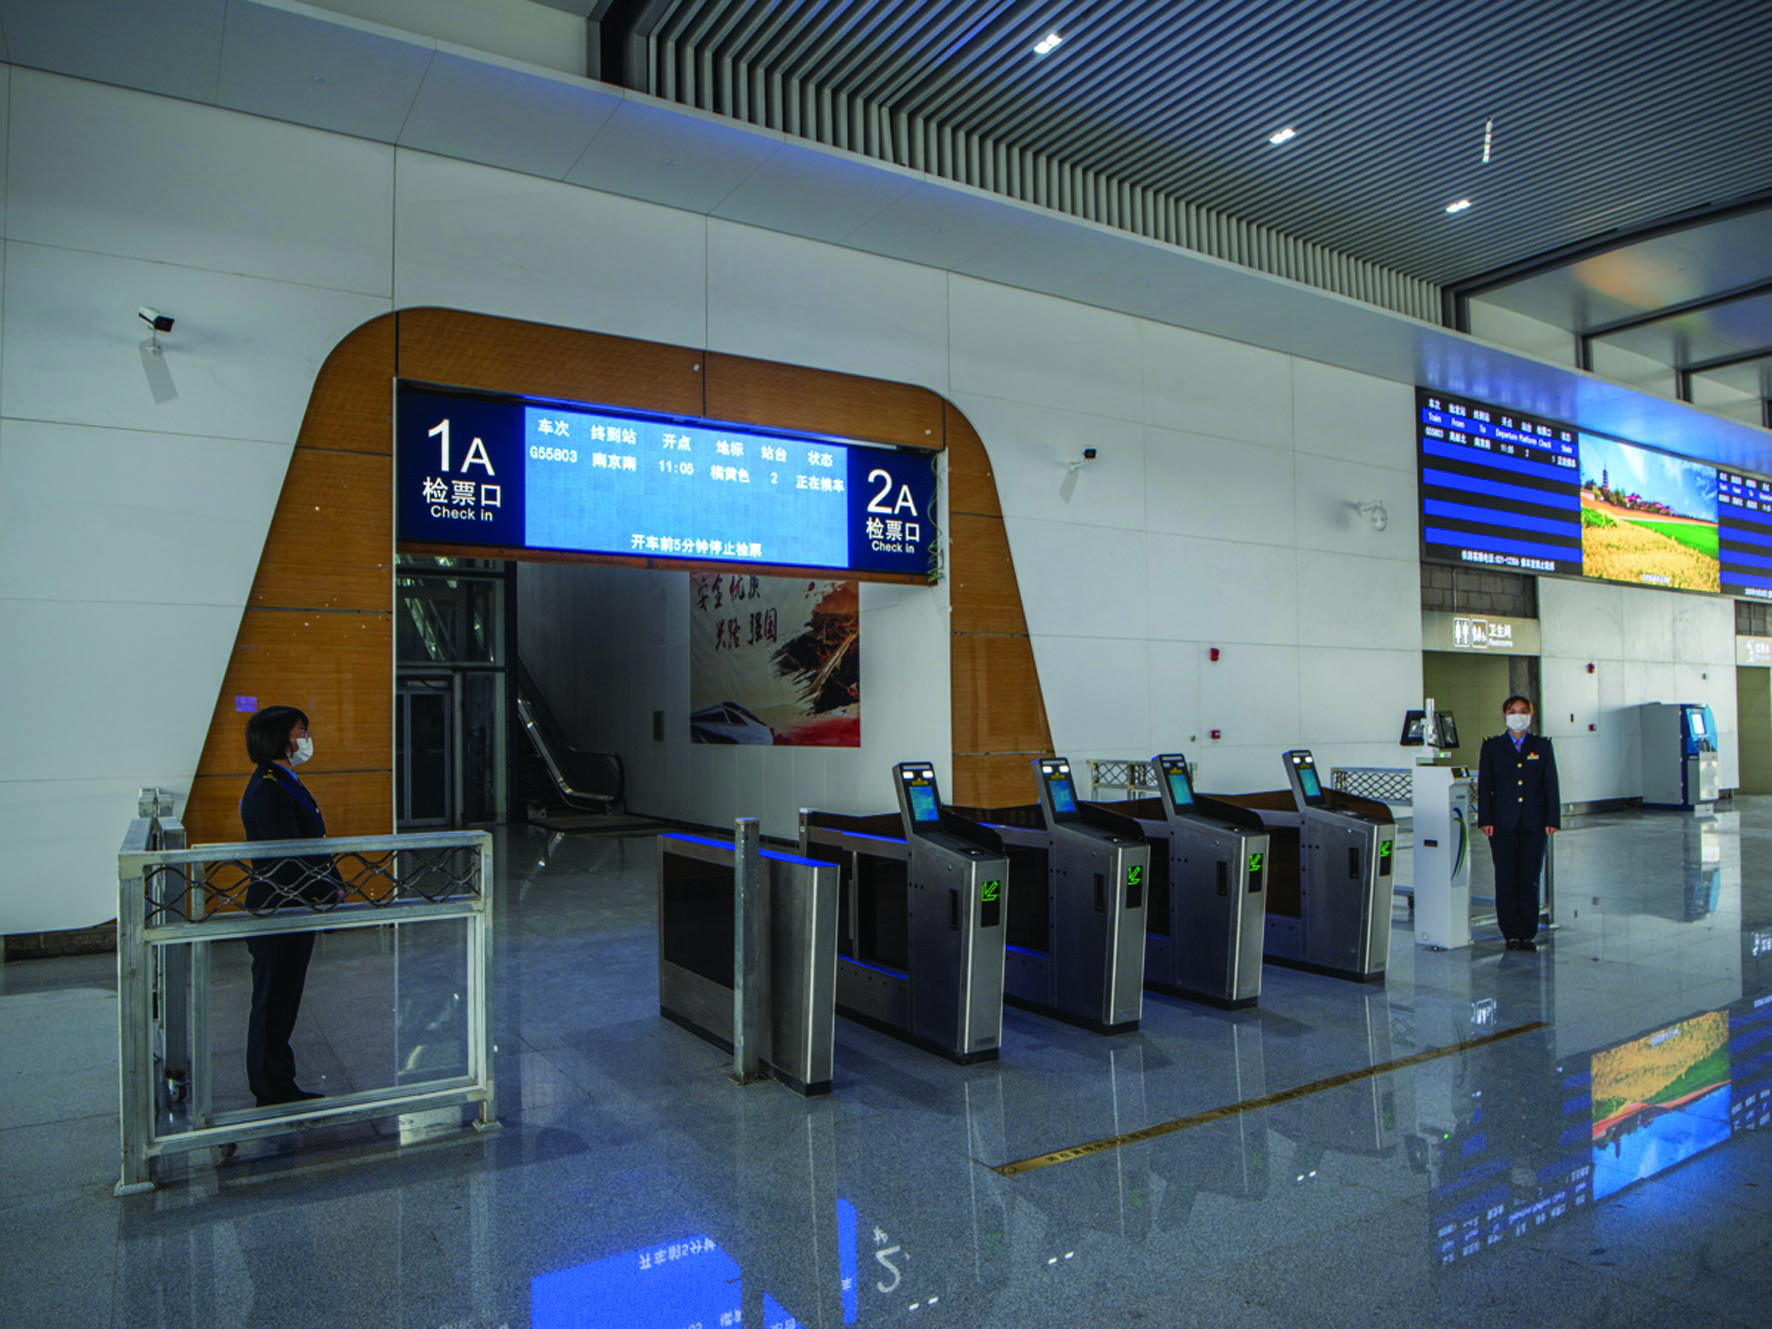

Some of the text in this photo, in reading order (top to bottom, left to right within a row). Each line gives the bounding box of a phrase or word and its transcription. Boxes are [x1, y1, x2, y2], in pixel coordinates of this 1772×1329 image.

[538, 418, 833, 468] 车次 终到站 开点 地标 站台 状态
[529, 446, 578, 463] G55803
[592, 452, 637, 472] 南京南
[659, 460, 695, 475] 11:05
[770, 472, 778, 484] 2
[796, 474, 845, 493] 正在候车
[422, 477, 502, 508] 检票口
[431, 505, 493, 522] Check in
[865, 517, 920, 543] 检票口
[631, 534, 763, 558] 开车前5分钟停止检票
[872, 540, 915, 553] Check in
